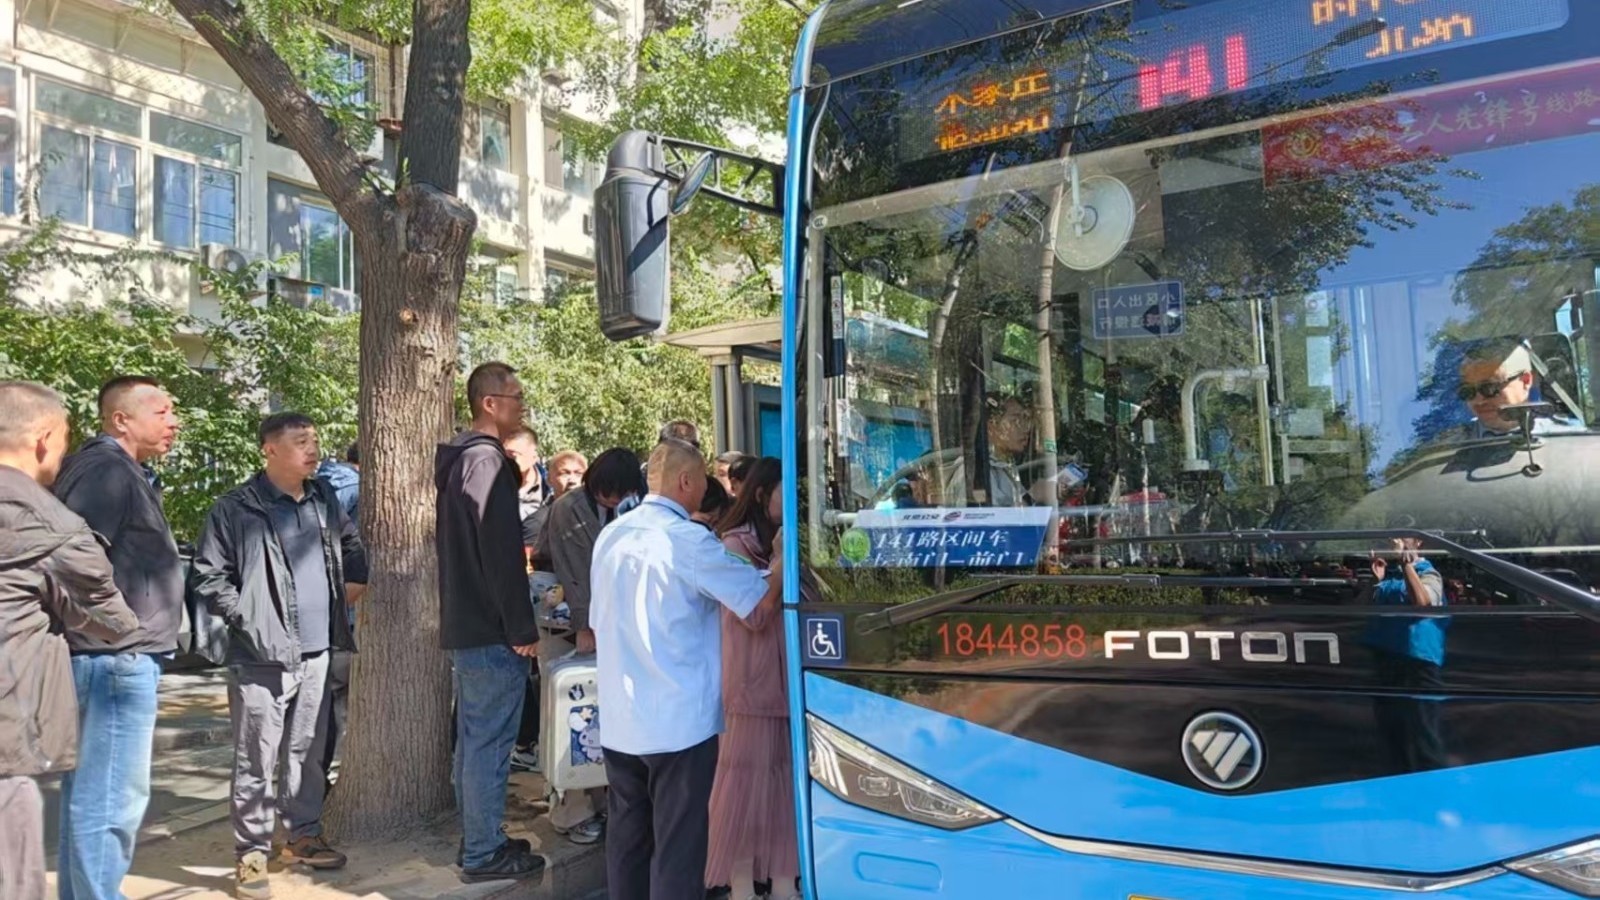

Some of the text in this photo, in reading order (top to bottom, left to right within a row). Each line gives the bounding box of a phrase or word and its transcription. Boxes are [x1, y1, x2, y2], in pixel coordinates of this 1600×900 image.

[1139, 32, 1247, 110] 141
[876, 529, 1009, 549] 141路区间车
[937, 622, 1086, 658] 1844858
[1104, 631, 1341, 664] FOTON
